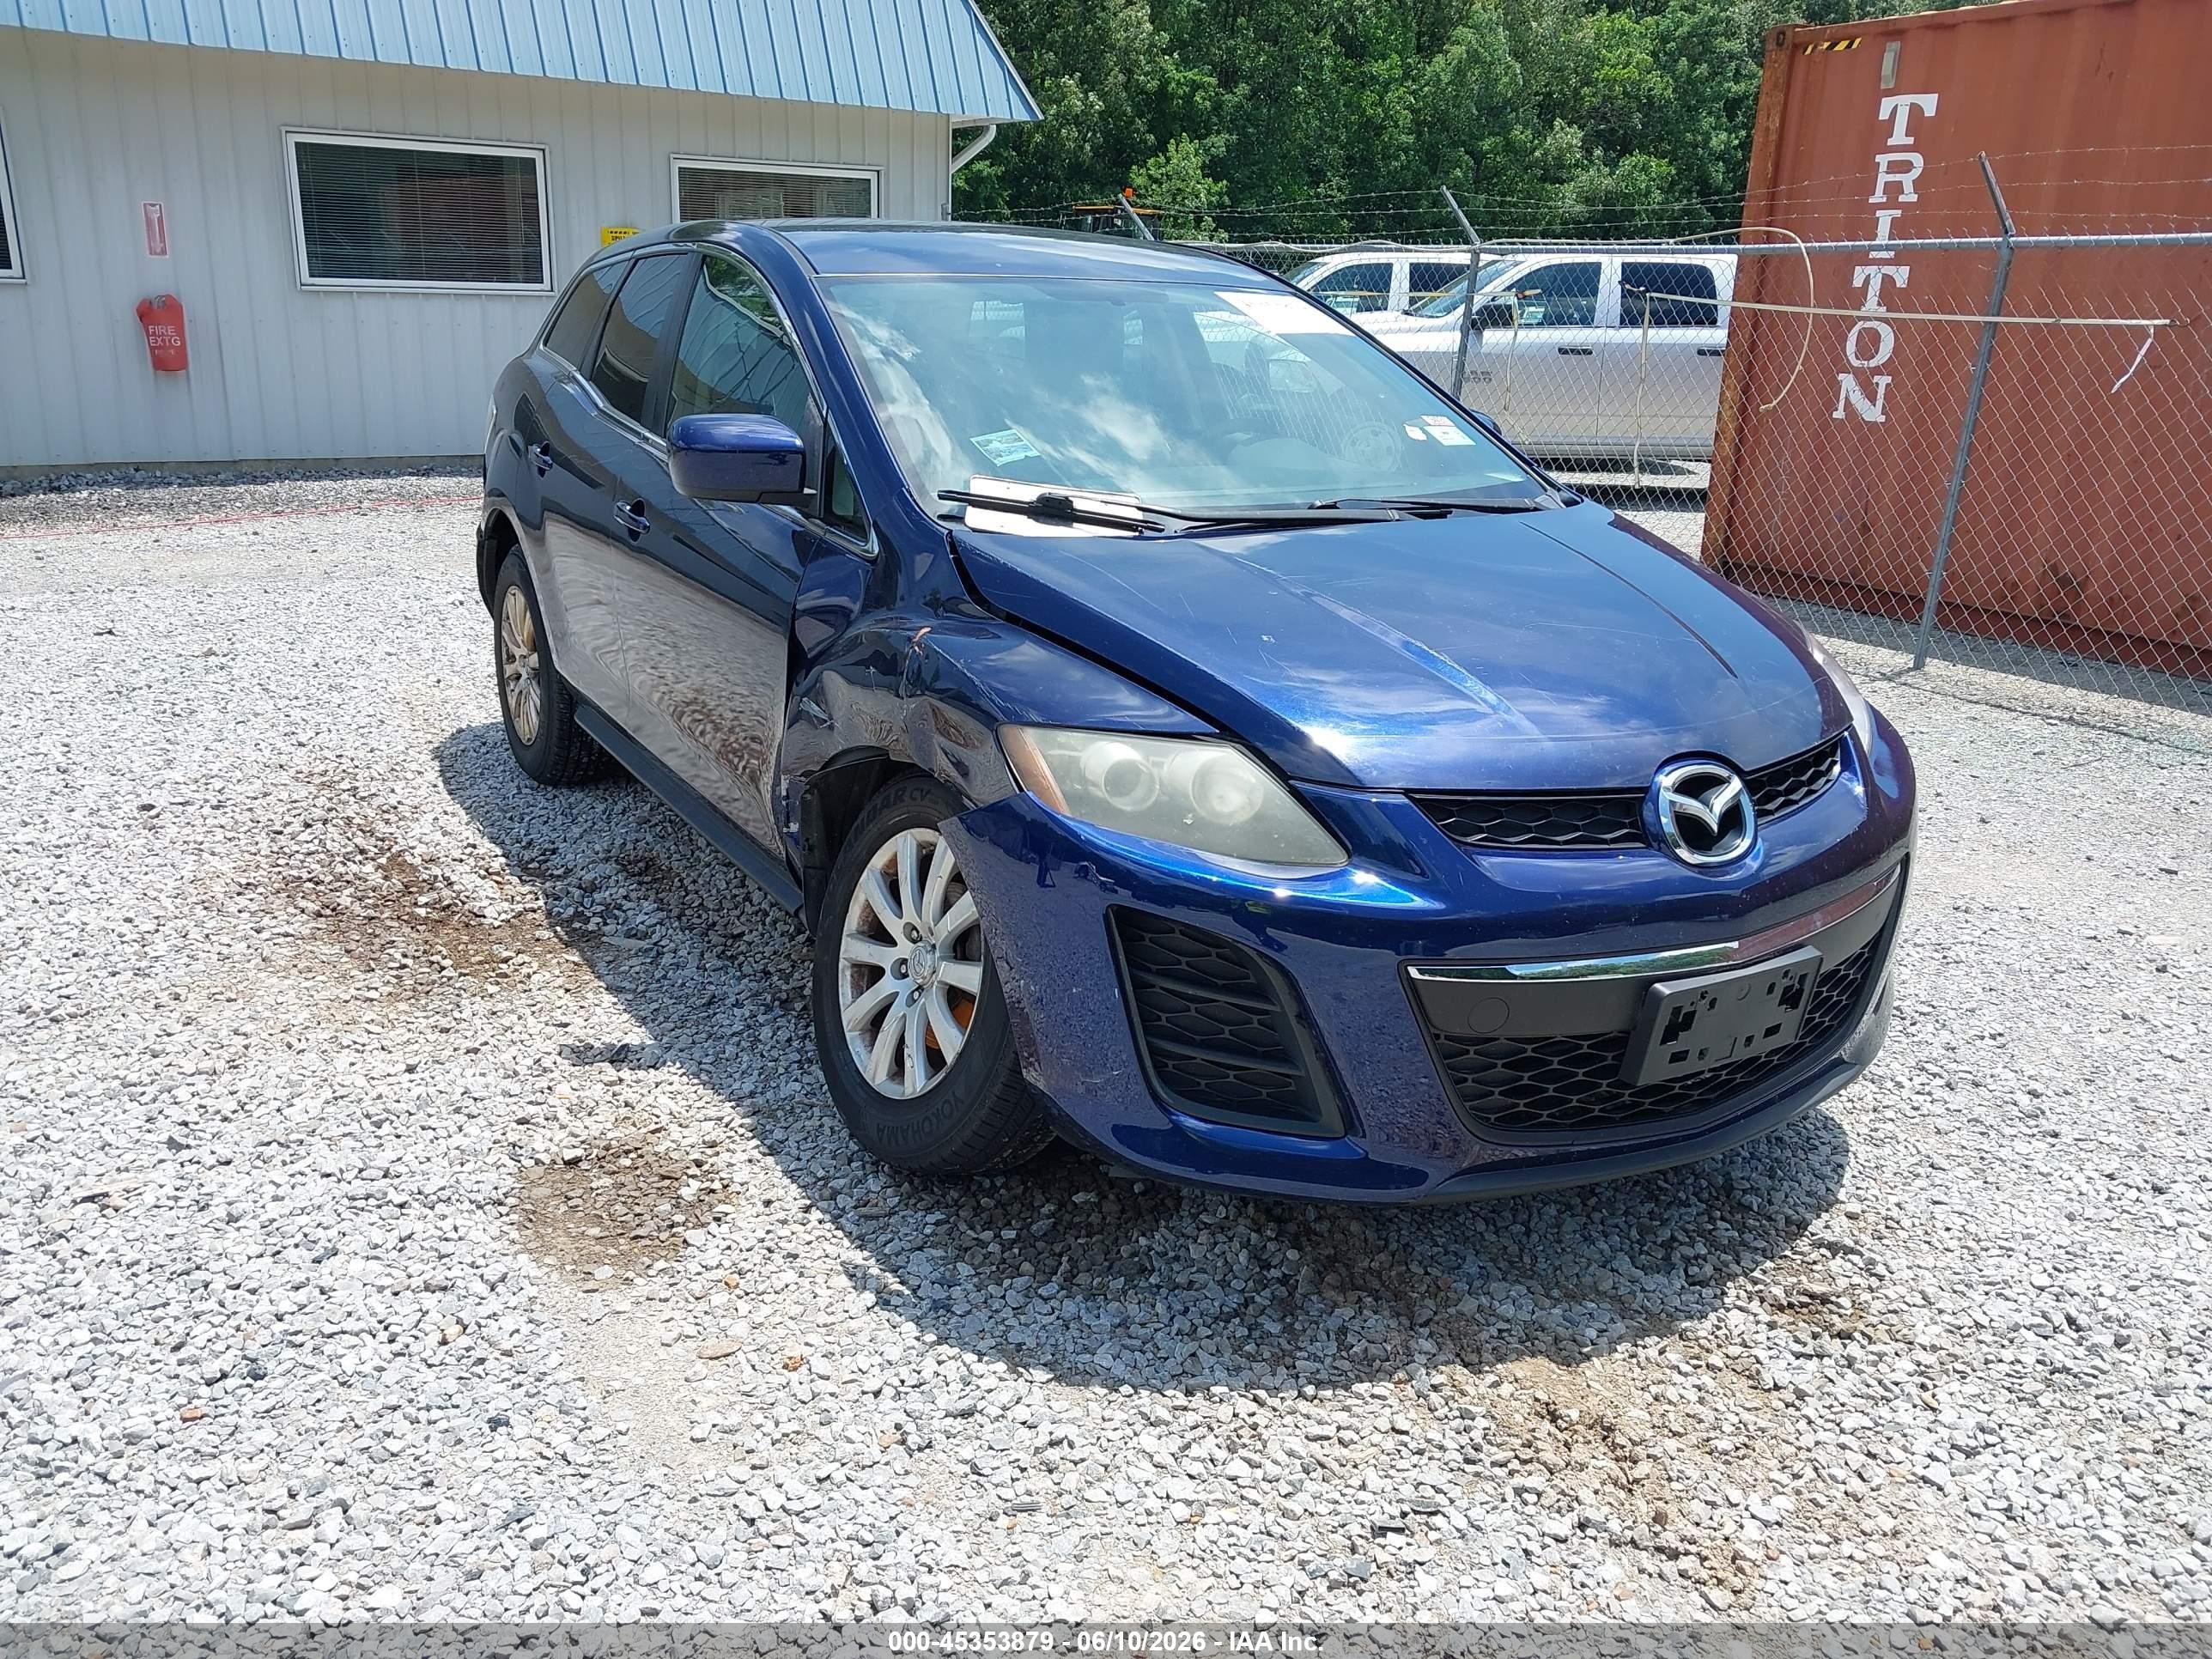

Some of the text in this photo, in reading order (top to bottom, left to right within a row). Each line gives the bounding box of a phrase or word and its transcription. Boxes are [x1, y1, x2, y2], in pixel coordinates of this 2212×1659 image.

[1832, 93, 1939, 422] TRITON
[148, 325, 177, 336] FIRE
[149, 336, 181, 347] EXTG
[876, 1089, 965, 1146] YOKOHAMA
